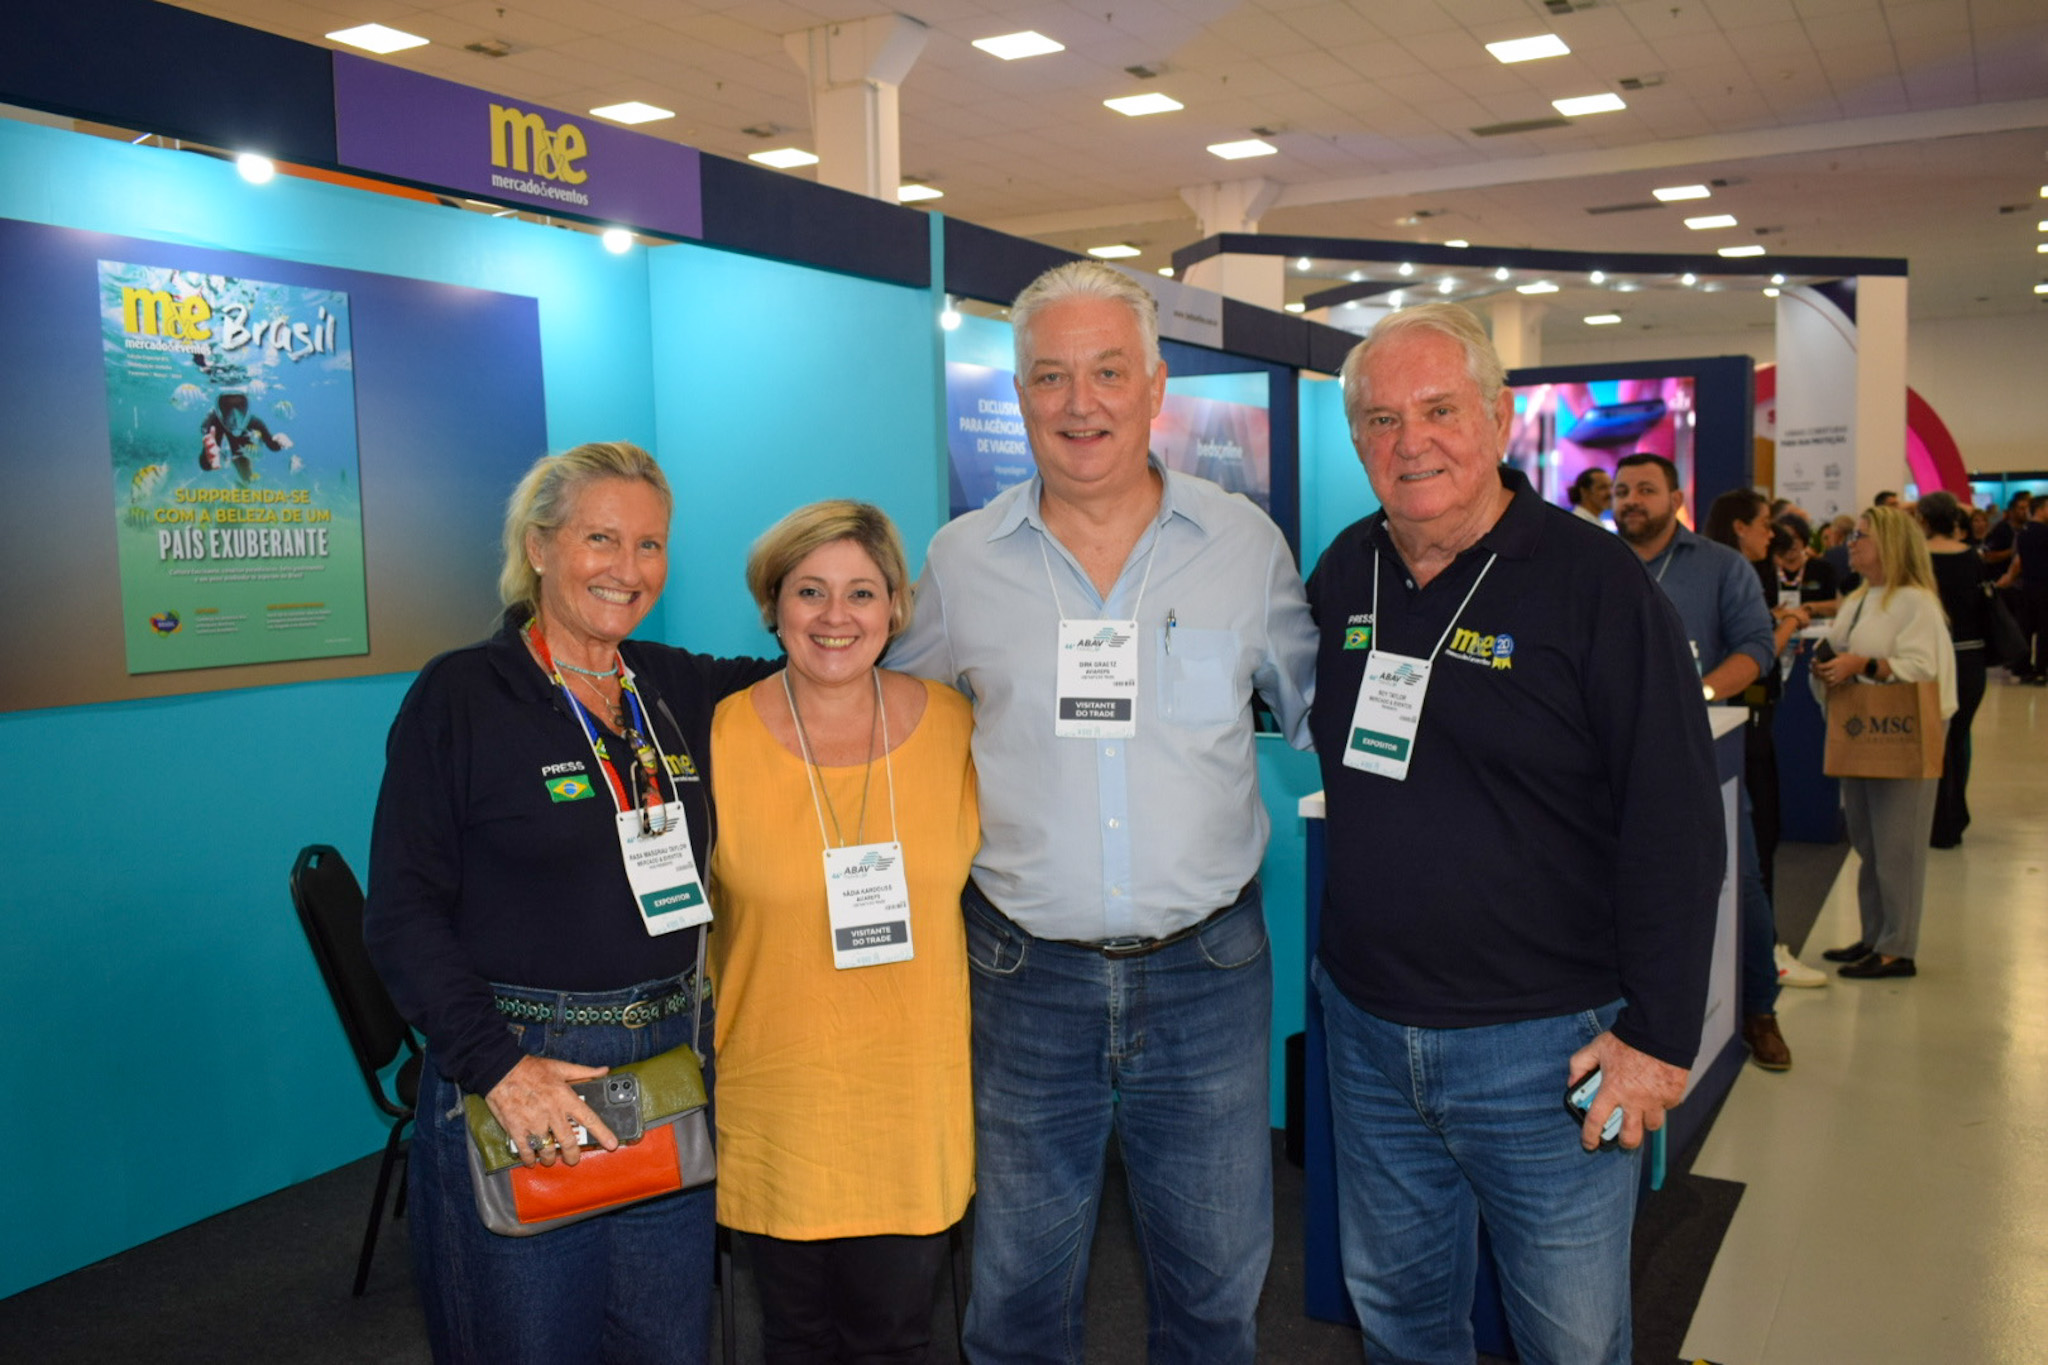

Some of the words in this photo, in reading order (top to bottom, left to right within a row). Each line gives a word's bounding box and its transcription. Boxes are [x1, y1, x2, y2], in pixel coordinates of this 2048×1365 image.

[489, 103, 588, 185] m&e
[491, 174, 589, 206] mercado&eventos
[121, 286, 213, 341] m&e
[220, 304, 336, 363] Brasil
[959, 417, 982, 433] PARA
[977, 438, 989, 453] DE
[990, 439, 1027, 455] VIAGENS
[174, 487, 311, 505] SURPREENDA-SE
[154, 508, 194, 524] COM
[199, 508, 212, 523] A
[216, 508, 277, 523] BELEZA
[282, 508, 301, 522] DE
[306, 507, 331, 522] UM
[158, 525, 205, 560] PAÍS
[210, 527, 328, 559] EXUBERANTE
[1348, 613, 1374, 625] PRESS
[1077, 639, 1104, 647] ABAV
[1075, 701, 1116, 709] VISITANTE
[1869, 716, 1915, 735] MSC
[1362, 737, 1398, 752] EXPOSITOR
[541, 761, 586, 777] PRESS
[844, 865, 870, 875] ABAV
[653, 892, 691, 908] EXPOSITOR
[850, 925, 891, 937] VISITANTE
[852, 938, 865, 946] DO
[866, 935, 892, 945] TRADE
